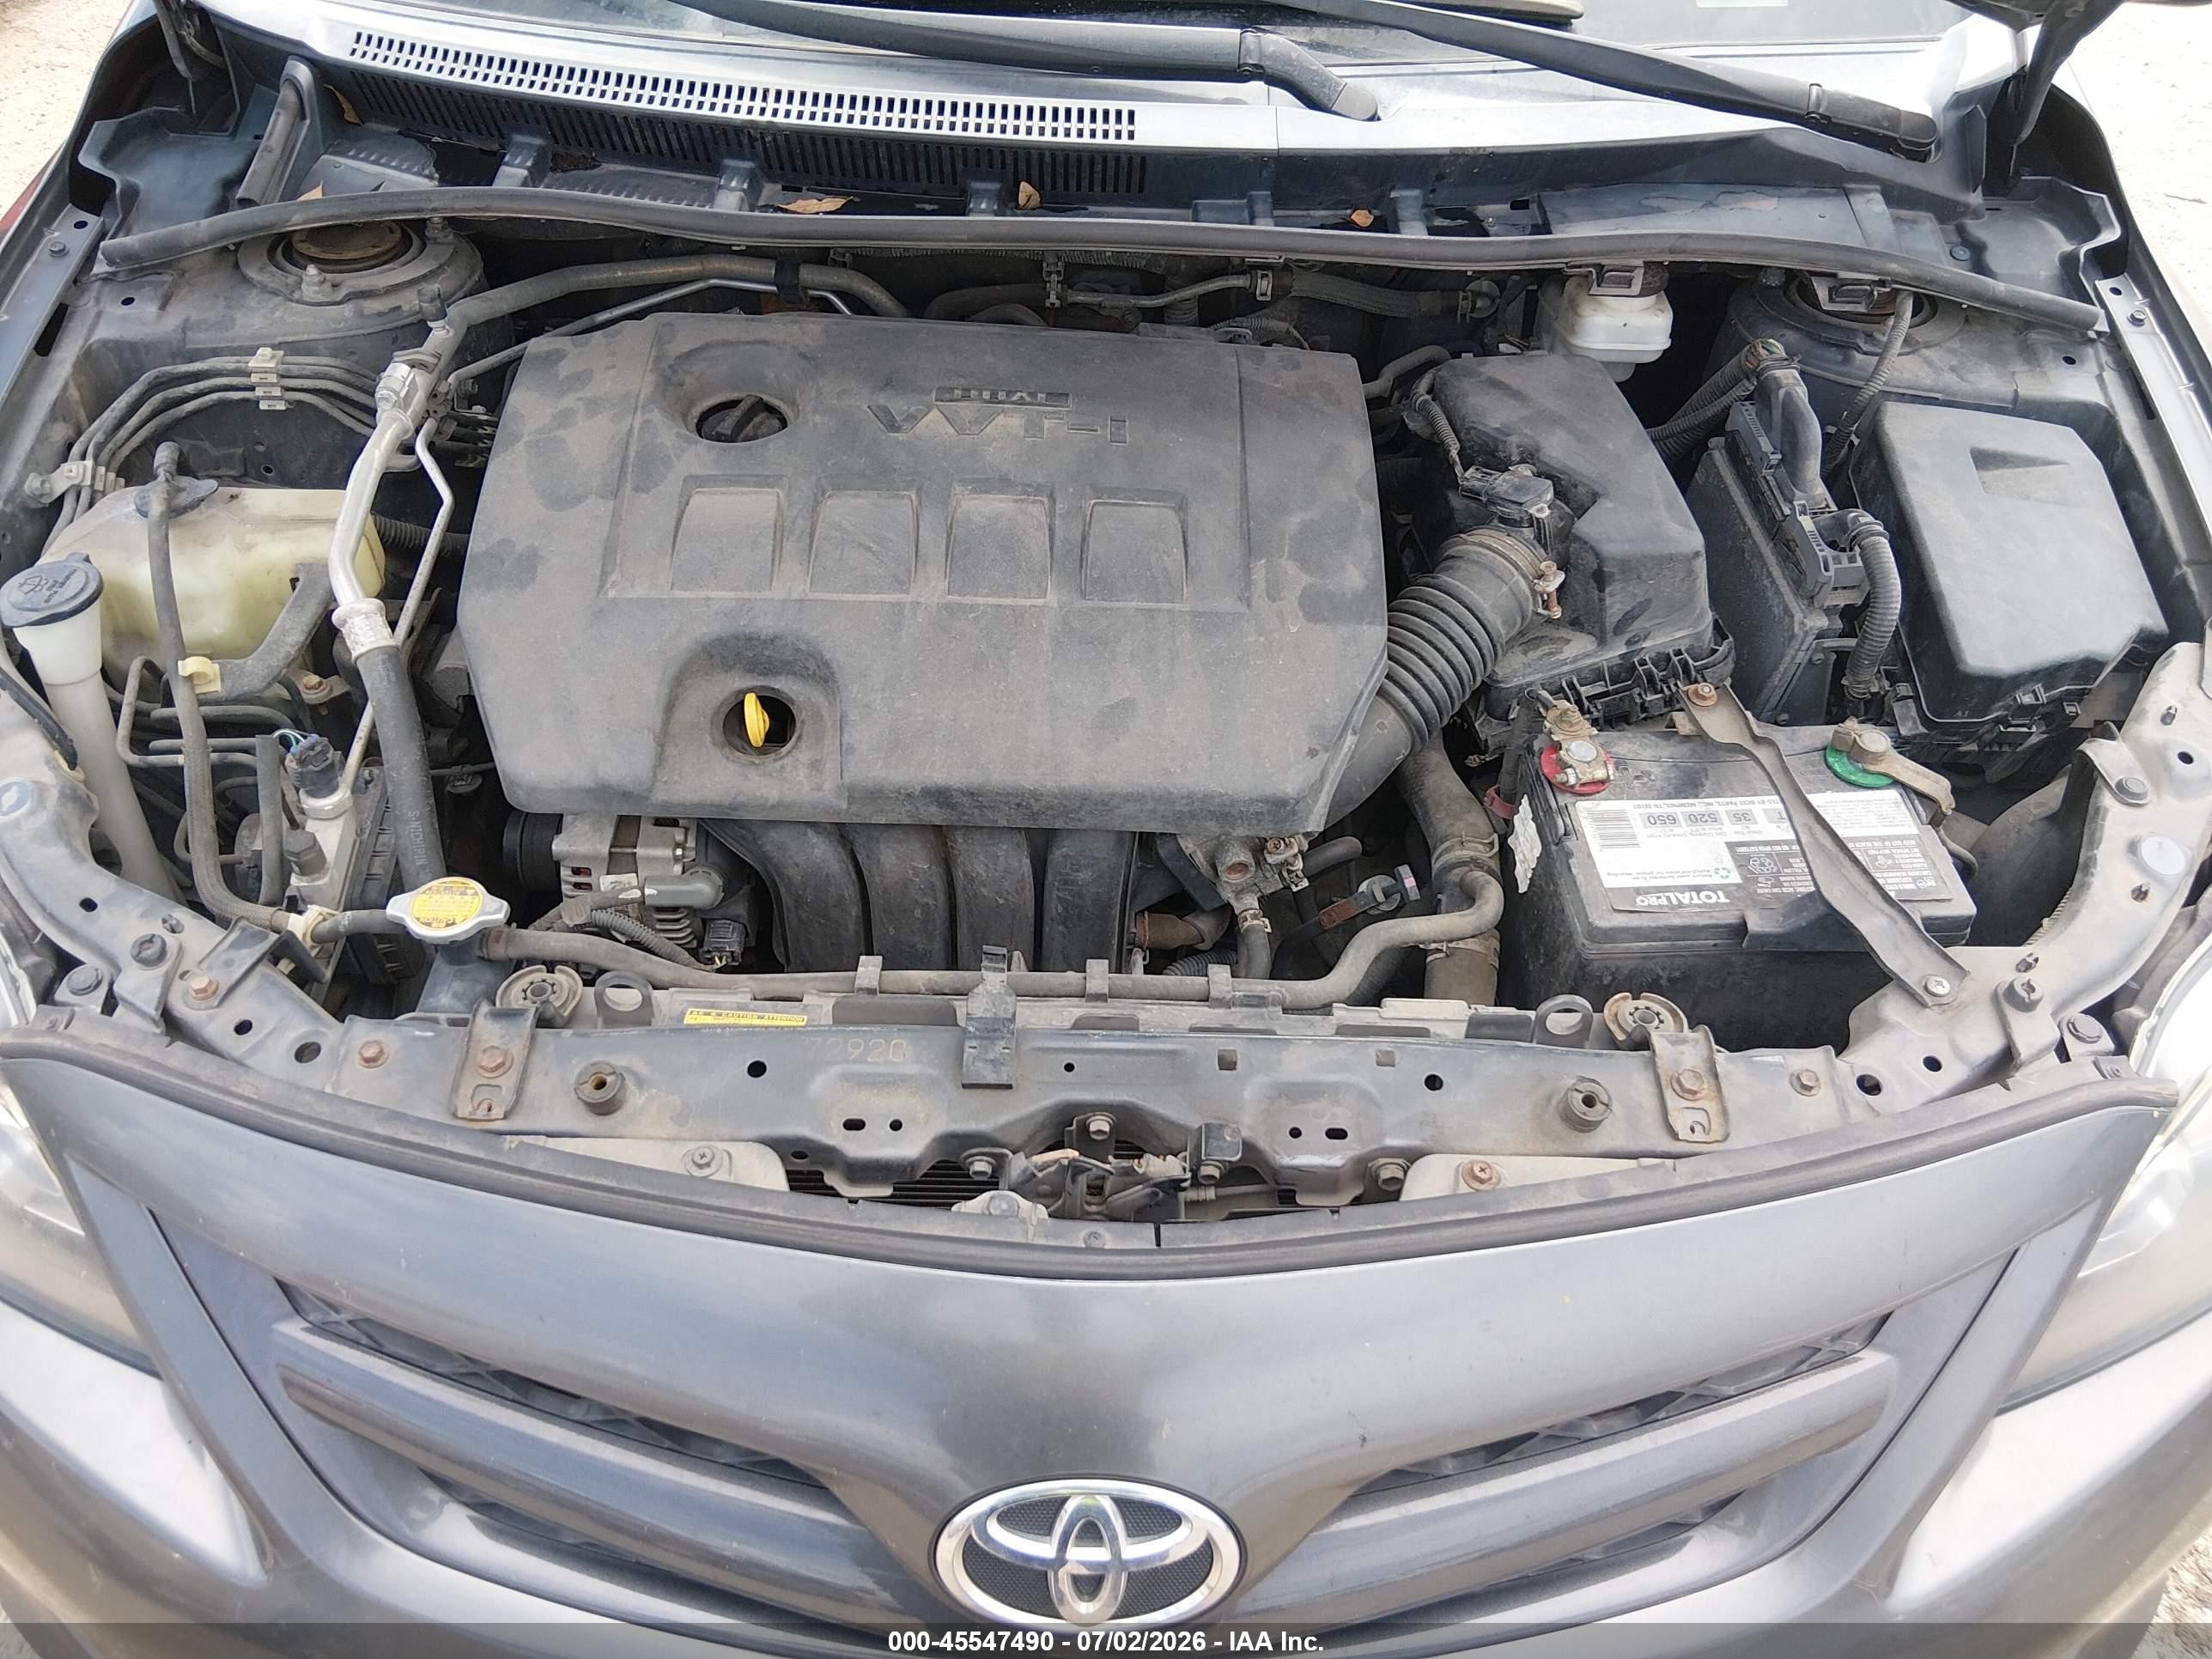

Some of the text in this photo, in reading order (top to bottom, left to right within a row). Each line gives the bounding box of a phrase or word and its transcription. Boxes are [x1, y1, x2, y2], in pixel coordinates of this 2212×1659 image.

[1647, 814, 1676, 825] 650
[1688, 812, 1718, 823] 520
[1733, 812, 1751, 822] 35
[1635, 890, 1730, 907] TOTALPRO
[764, 1014, 805, 1023] ATTENTION
